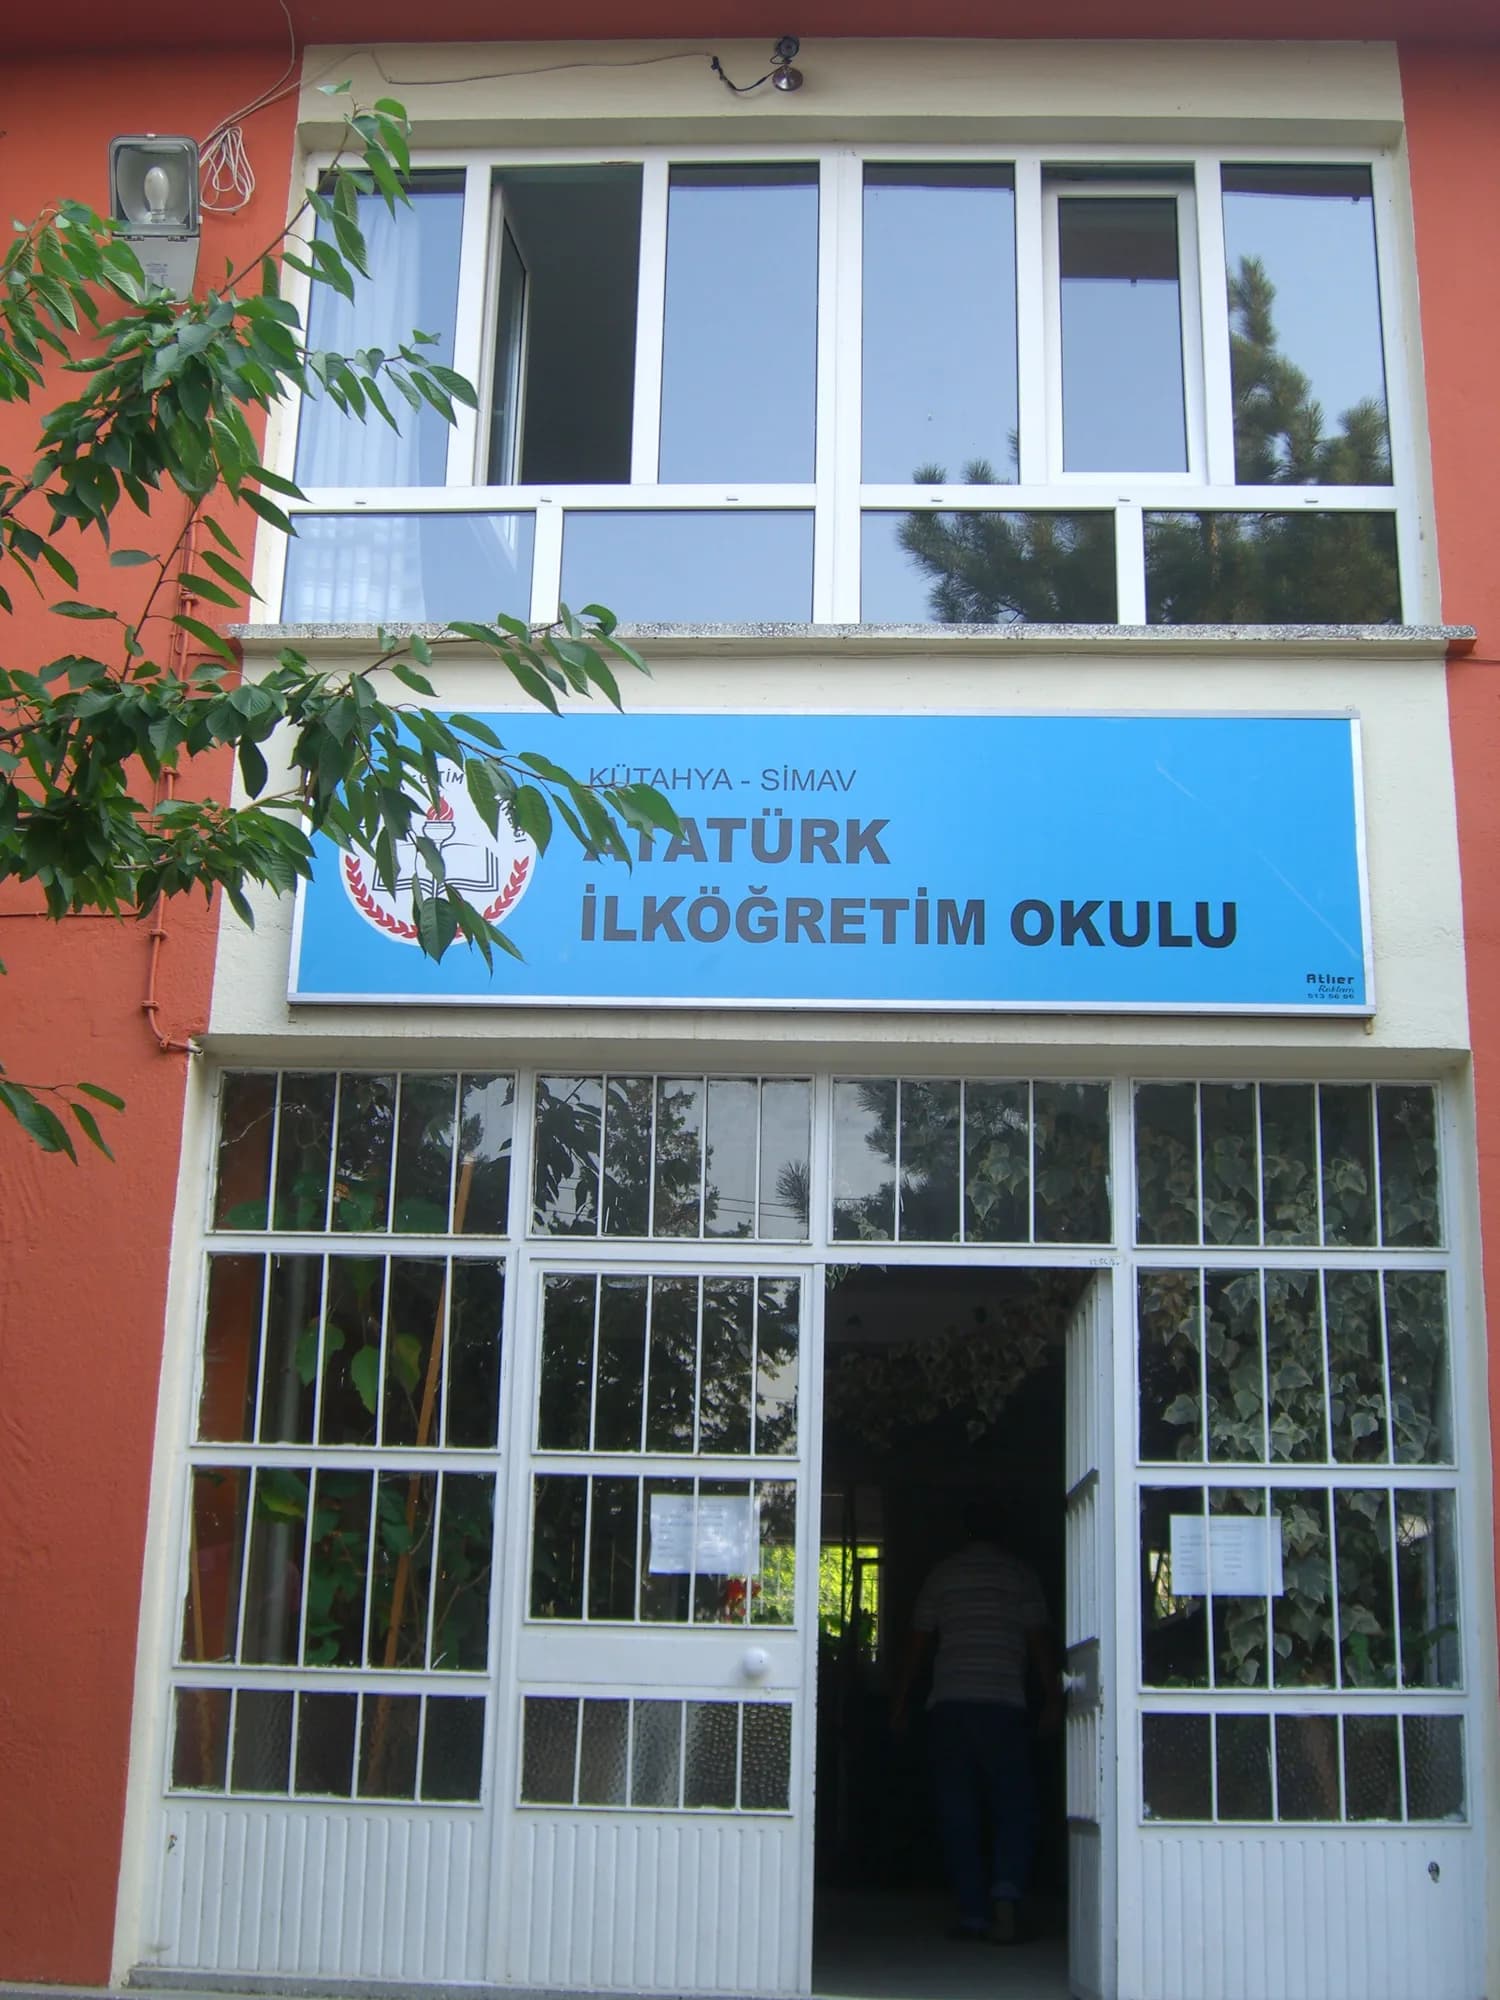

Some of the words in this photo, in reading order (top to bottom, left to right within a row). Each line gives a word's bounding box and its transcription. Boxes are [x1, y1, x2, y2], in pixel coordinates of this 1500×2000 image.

[590, 764, 734, 791] KÜTAHYA
[760, 765, 857, 792] SİMAV
[581, 883, 985, 945] İLKÖĞRETİM
[1010, 899, 1237, 949] OKULU
